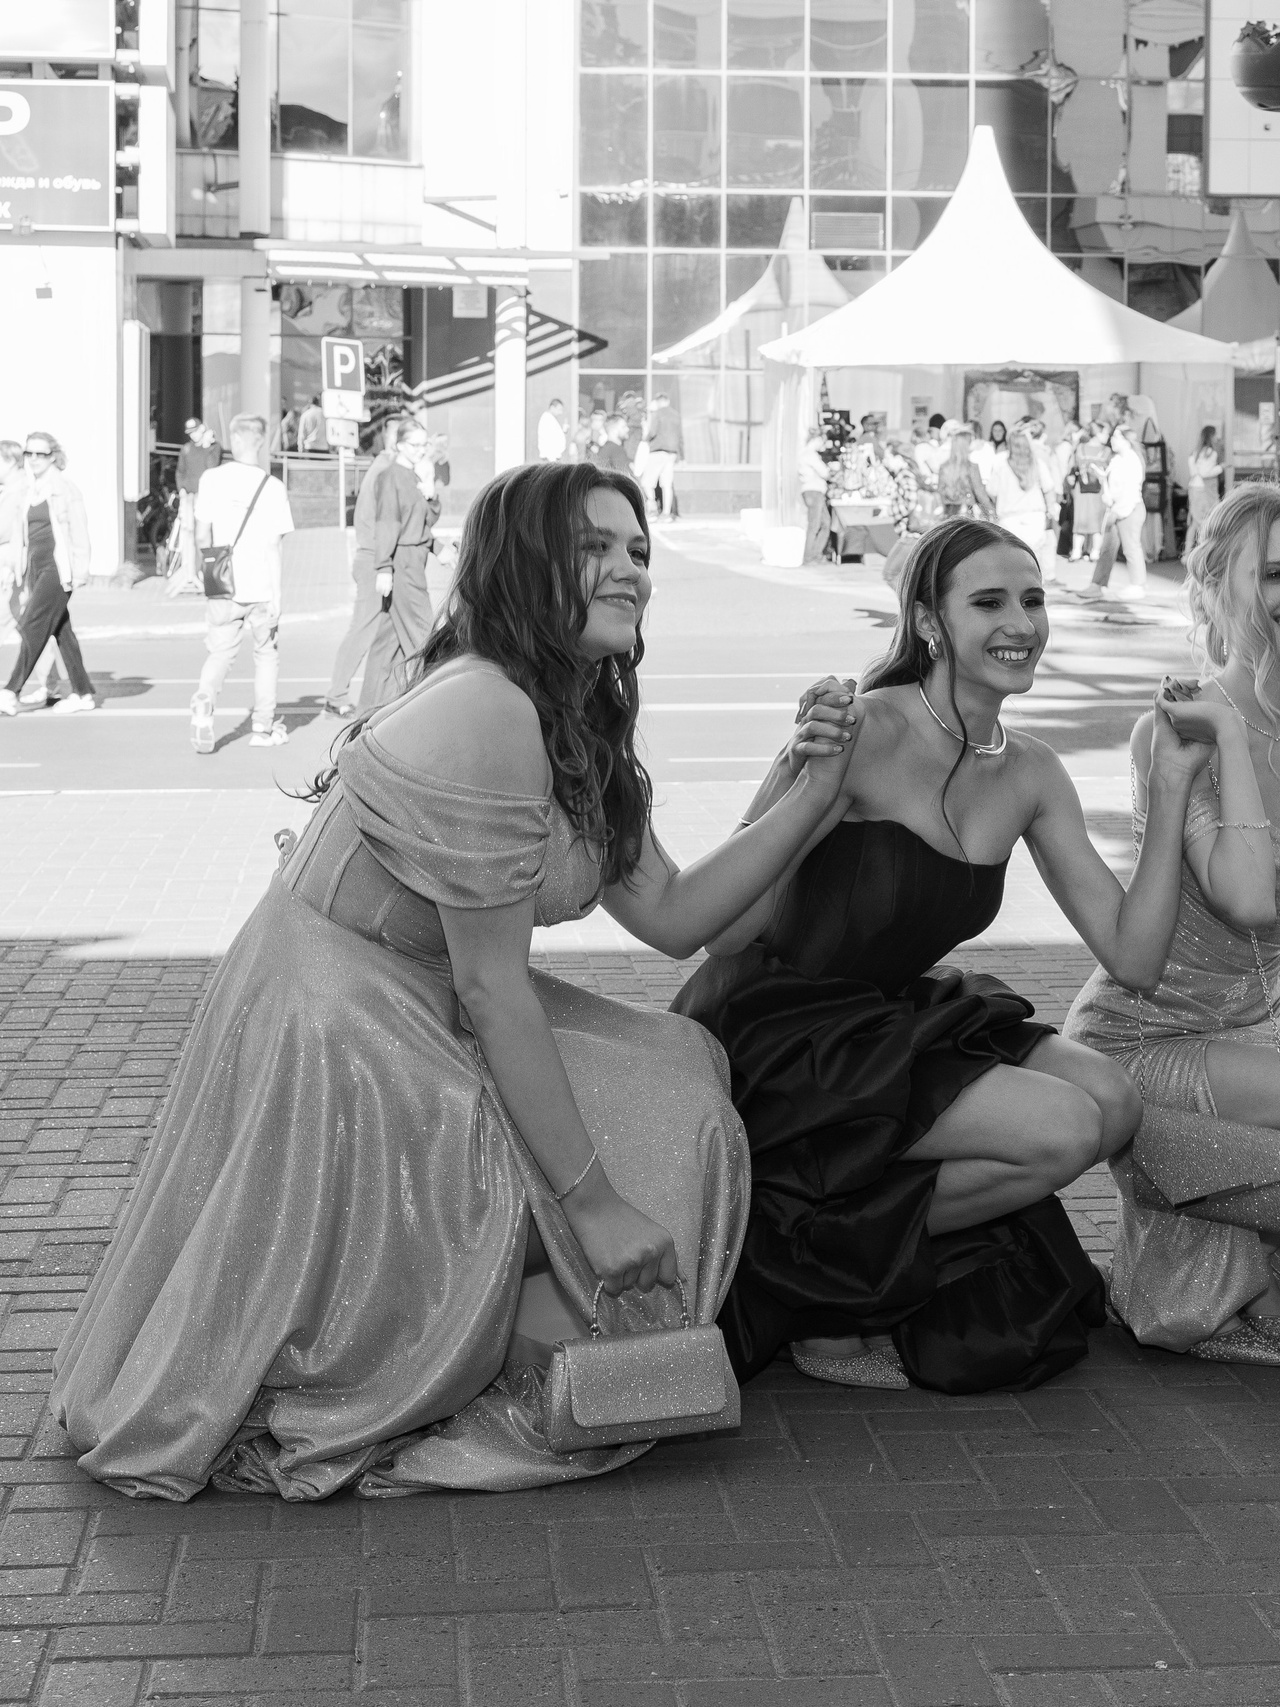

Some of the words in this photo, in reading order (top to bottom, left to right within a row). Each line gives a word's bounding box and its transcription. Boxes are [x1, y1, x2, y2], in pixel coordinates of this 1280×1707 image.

[38, 177, 50, 189] и
[52, 174, 102, 193] обувь
[333, 344, 356, 388] P
